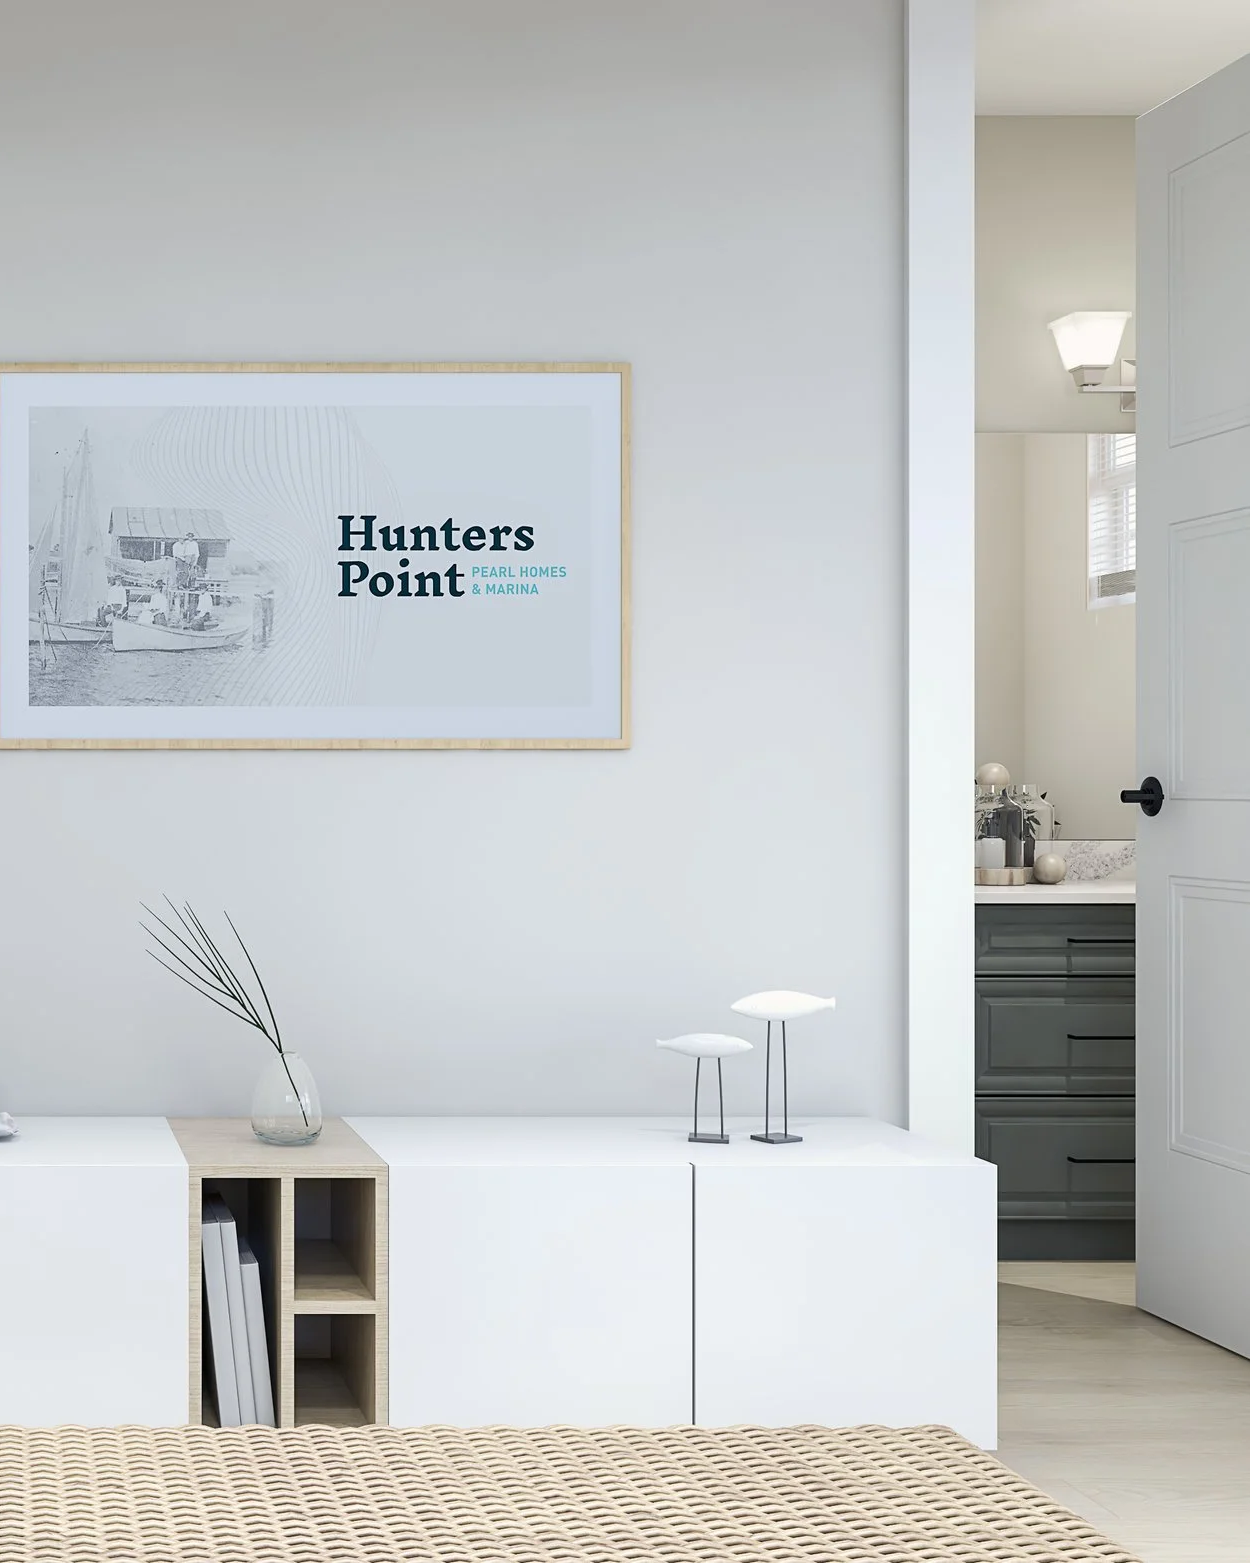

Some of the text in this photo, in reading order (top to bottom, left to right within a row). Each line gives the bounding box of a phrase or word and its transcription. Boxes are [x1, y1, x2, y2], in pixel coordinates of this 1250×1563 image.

[337, 515, 535, 551] Hunters
[337, 558, 466, 598] Point
[471, 566, 567, 578] PEARL HOMES
[471, 583, 539, 595] & MARINA
